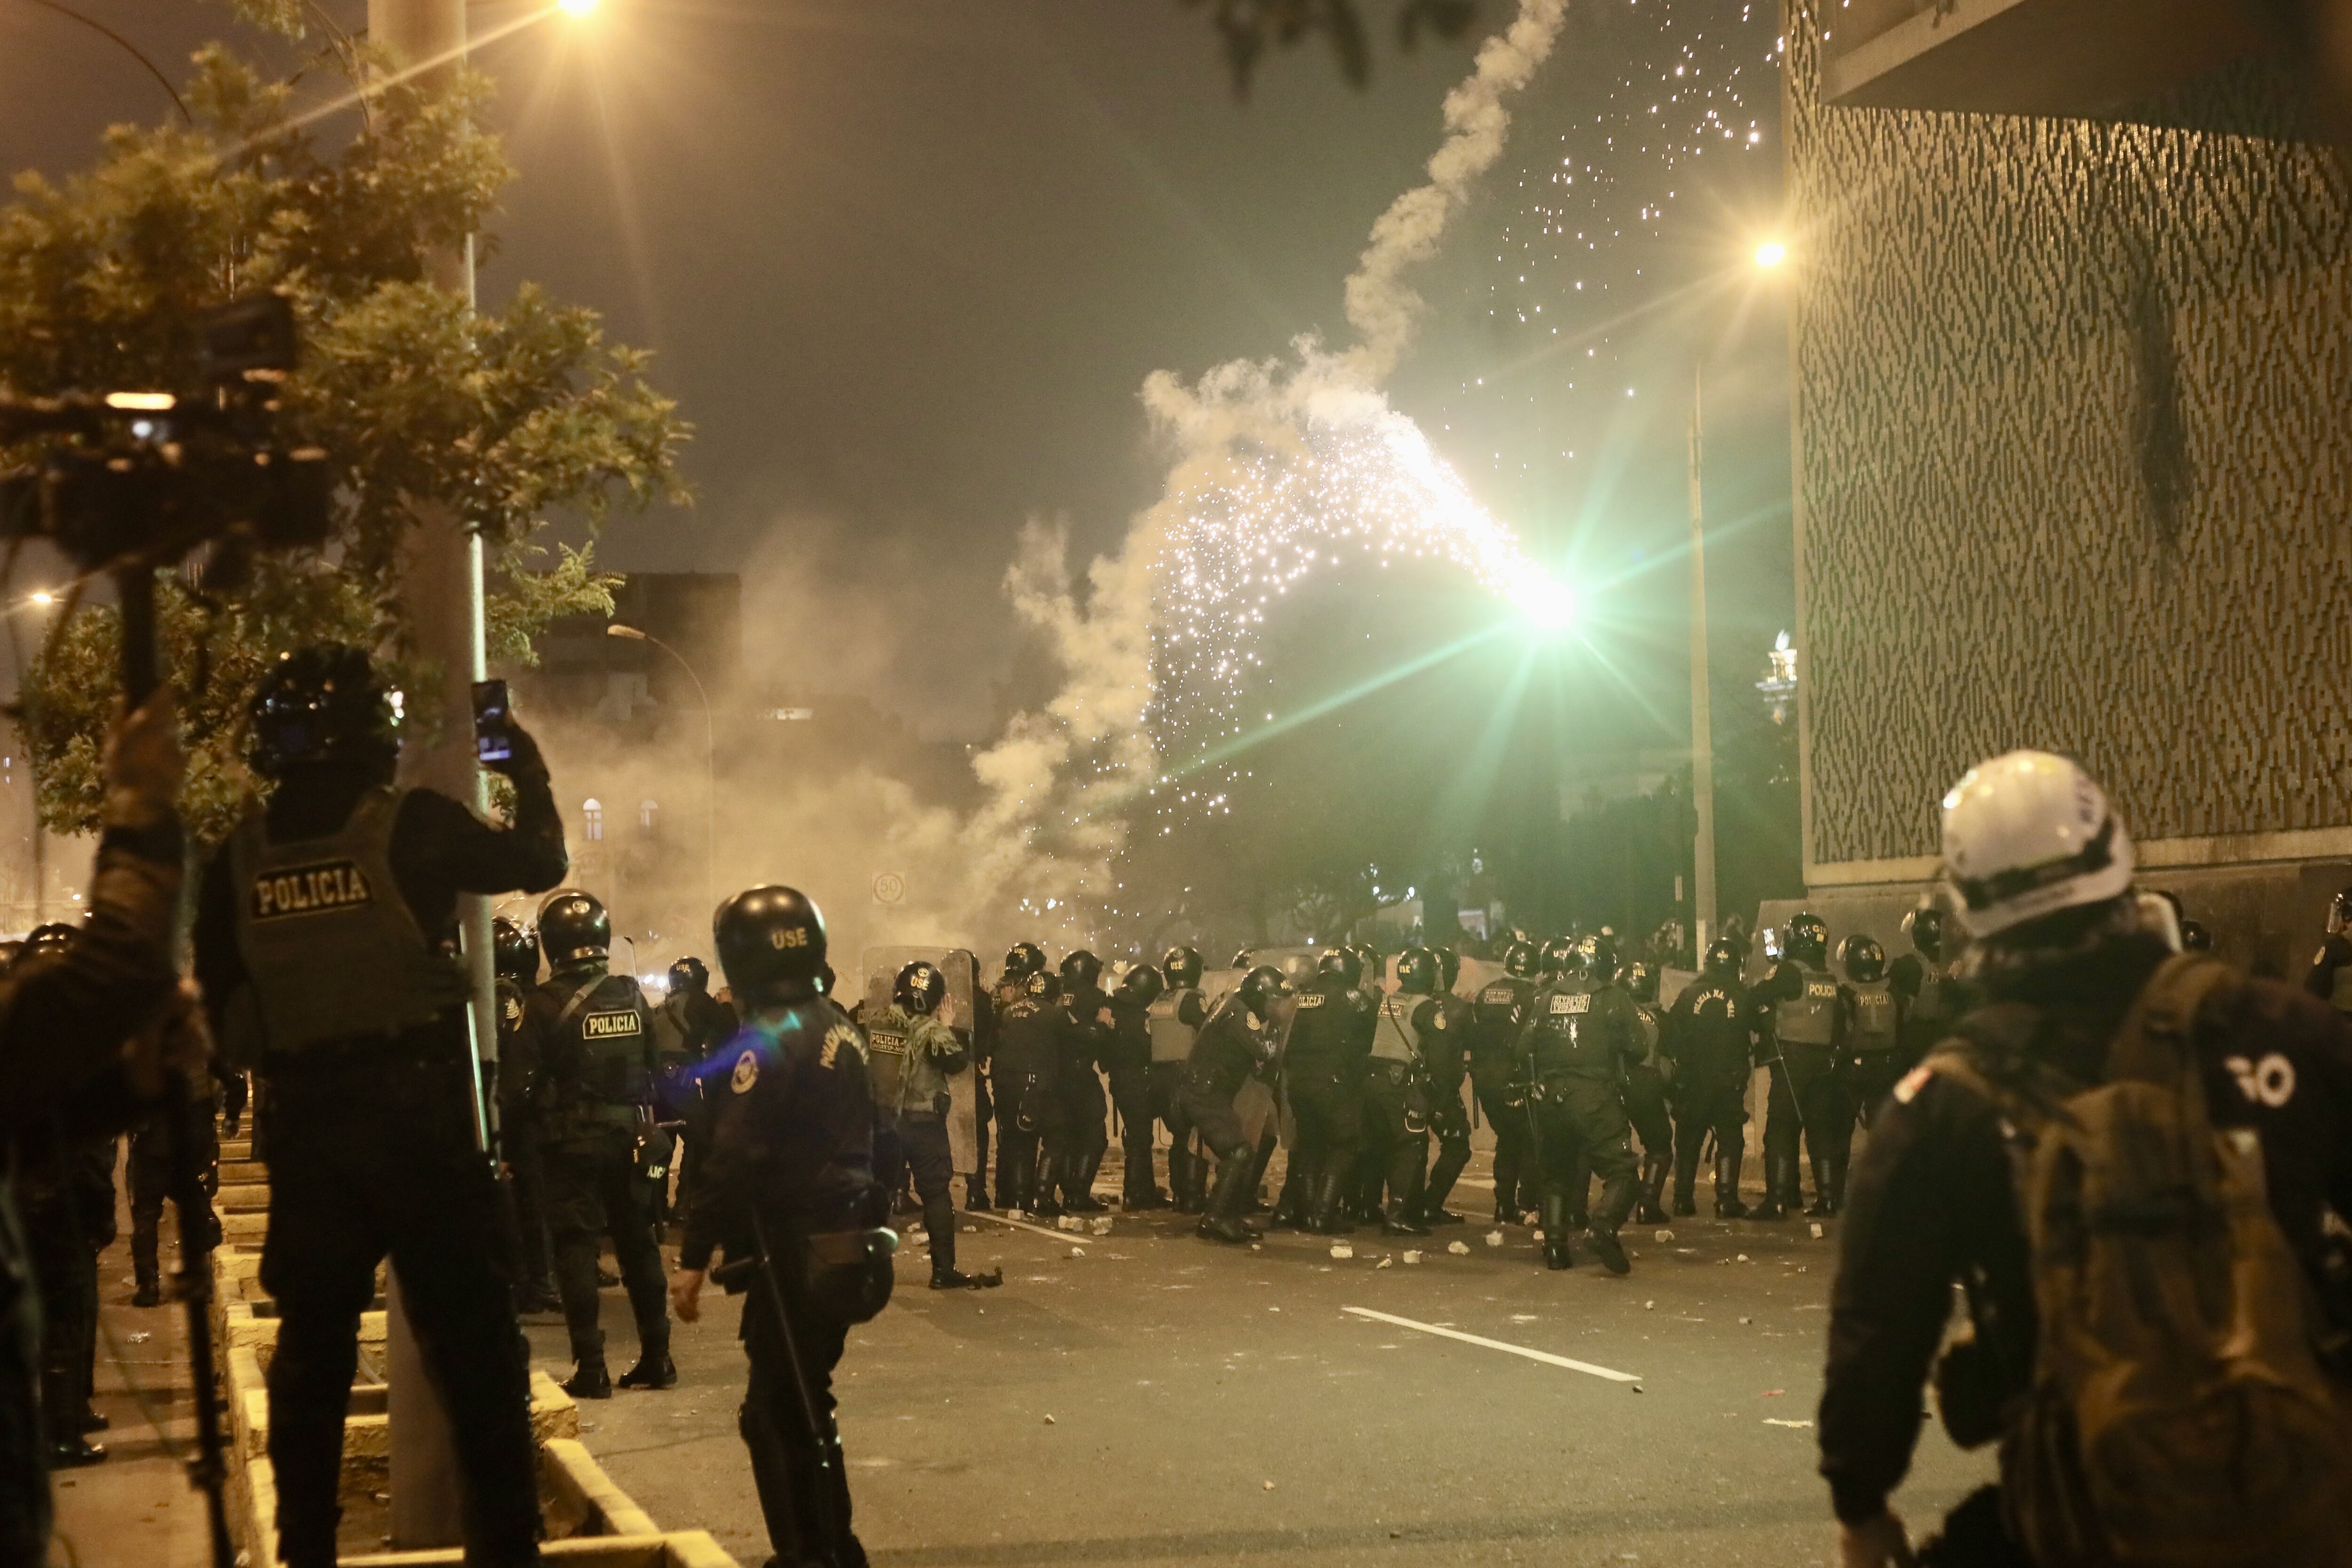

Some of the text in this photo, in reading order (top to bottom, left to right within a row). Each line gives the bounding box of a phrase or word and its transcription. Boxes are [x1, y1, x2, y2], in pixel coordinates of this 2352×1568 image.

[256, 868, 367, 914] POLICIA
[880, 878, 898, 892] 50
[771, 927, 808, 949] USE
[1578, 944, 1596, 954] USE
[676, 963, 690, 972] USE
[1170, 962, 1183, 970] USE
[1399, 965, 1410, 973] USE
[911, 976, 930, 991] USE
[1298, 996, 1322, 1007] OLICIA
[589, 1015, 636, 1034] POLICIA
